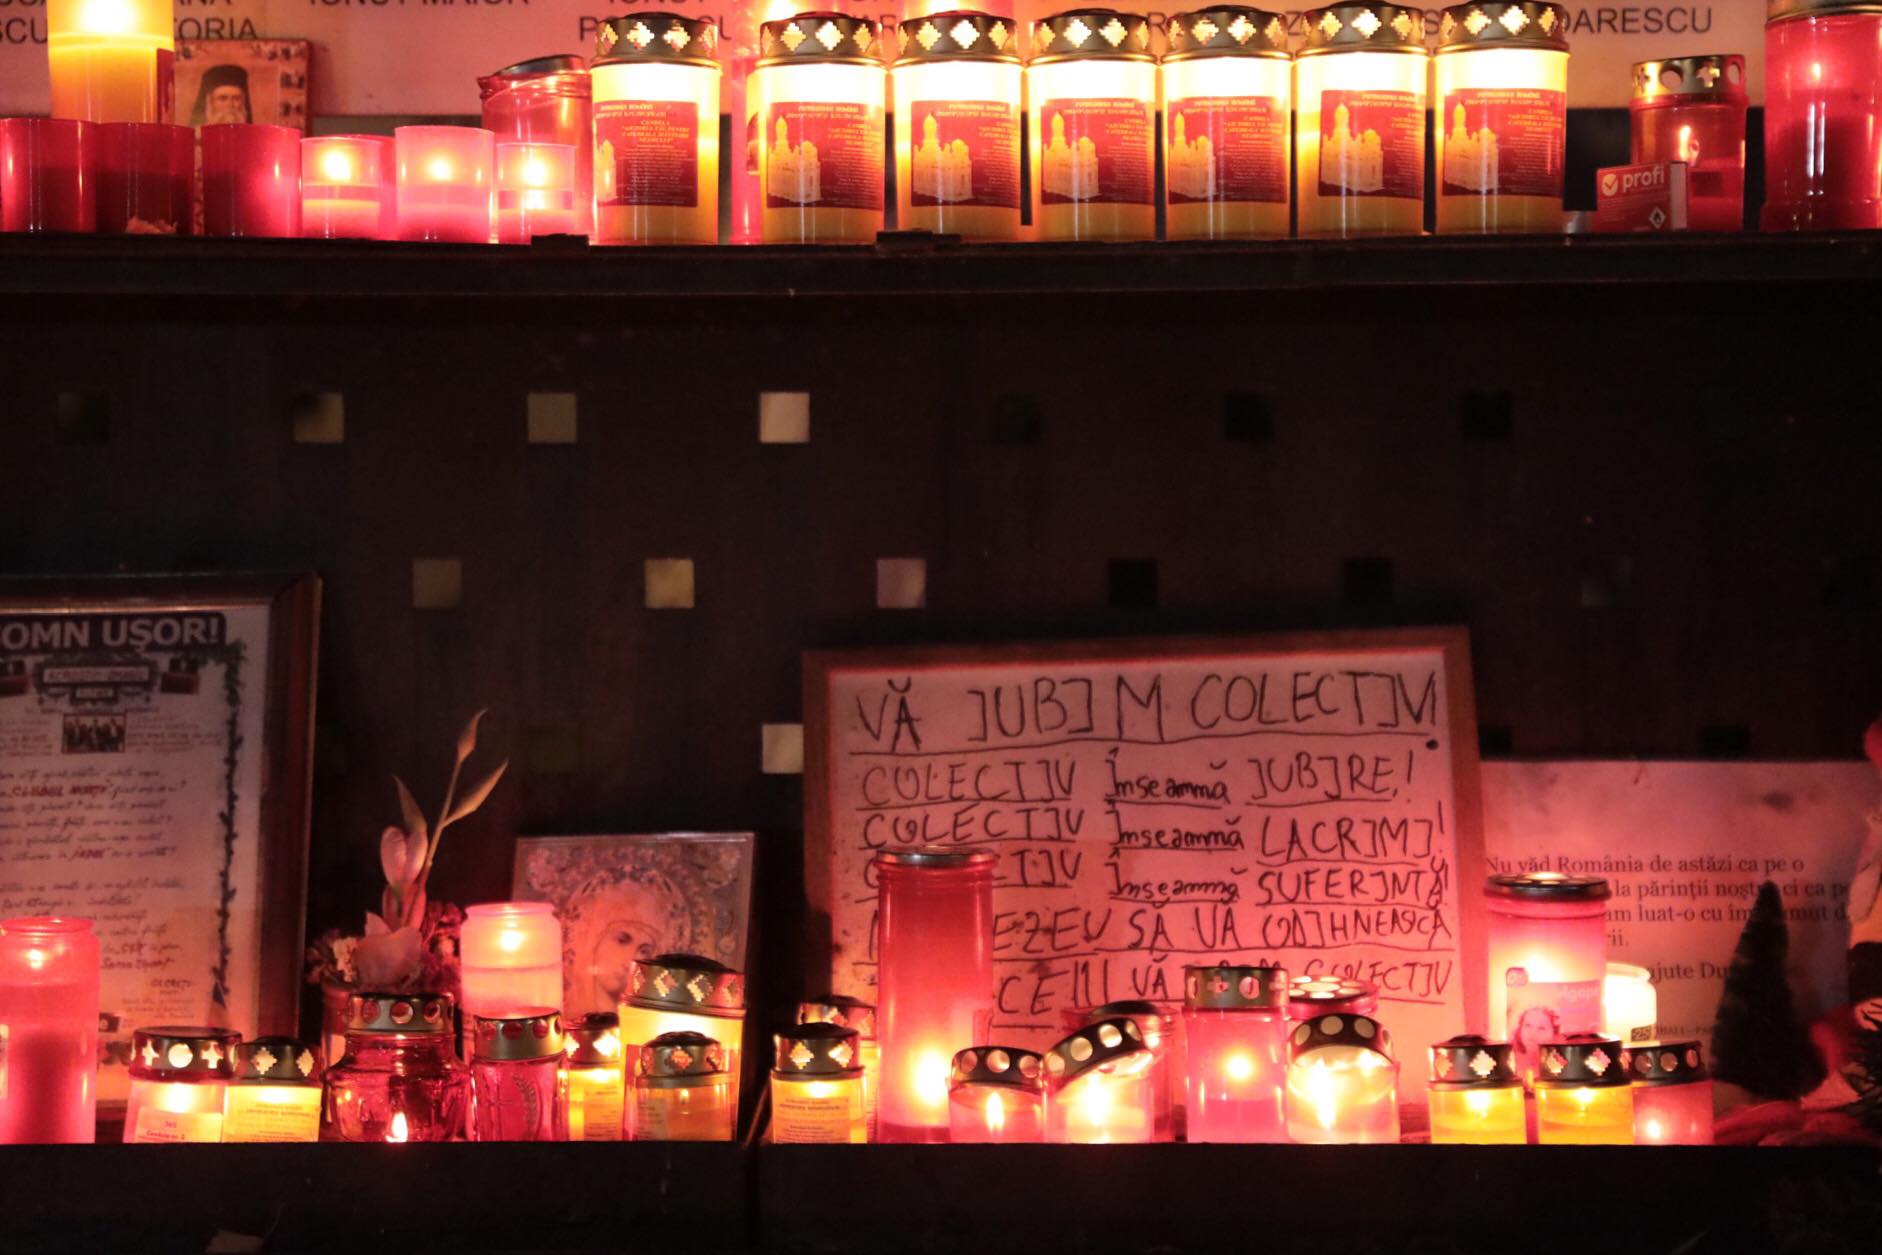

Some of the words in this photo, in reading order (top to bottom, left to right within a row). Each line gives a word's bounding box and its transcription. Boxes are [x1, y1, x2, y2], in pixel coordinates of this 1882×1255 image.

[1622, 165, 1665, 193] profi
[856, 676, 922, 752] VĂ
[862, 757, 1077, 806] COLECTIV
[863, 802, 1085, 848] COLECTIV
[1486, 856, 1512, 872] Nu
[1517, 855, 1550, 873] văd
[1558, 854, 1644, 873] România
[1649, 854, 1672, 873] de
[1678, 854, 1733, 873] astăzi
[1738, 859, 1758, 872] ca
[1764, 859, 1787, 876] pe
[1792, 859, 1805, 872] o
[1615, 879, 1631, 897] la
[1804, 884, 1825, 897] ca
[1638, 904, 1695, 922] luat-o
[1700, 909, 1722, 922] cu
[1132, 953, 1169, 1000] VĂ
